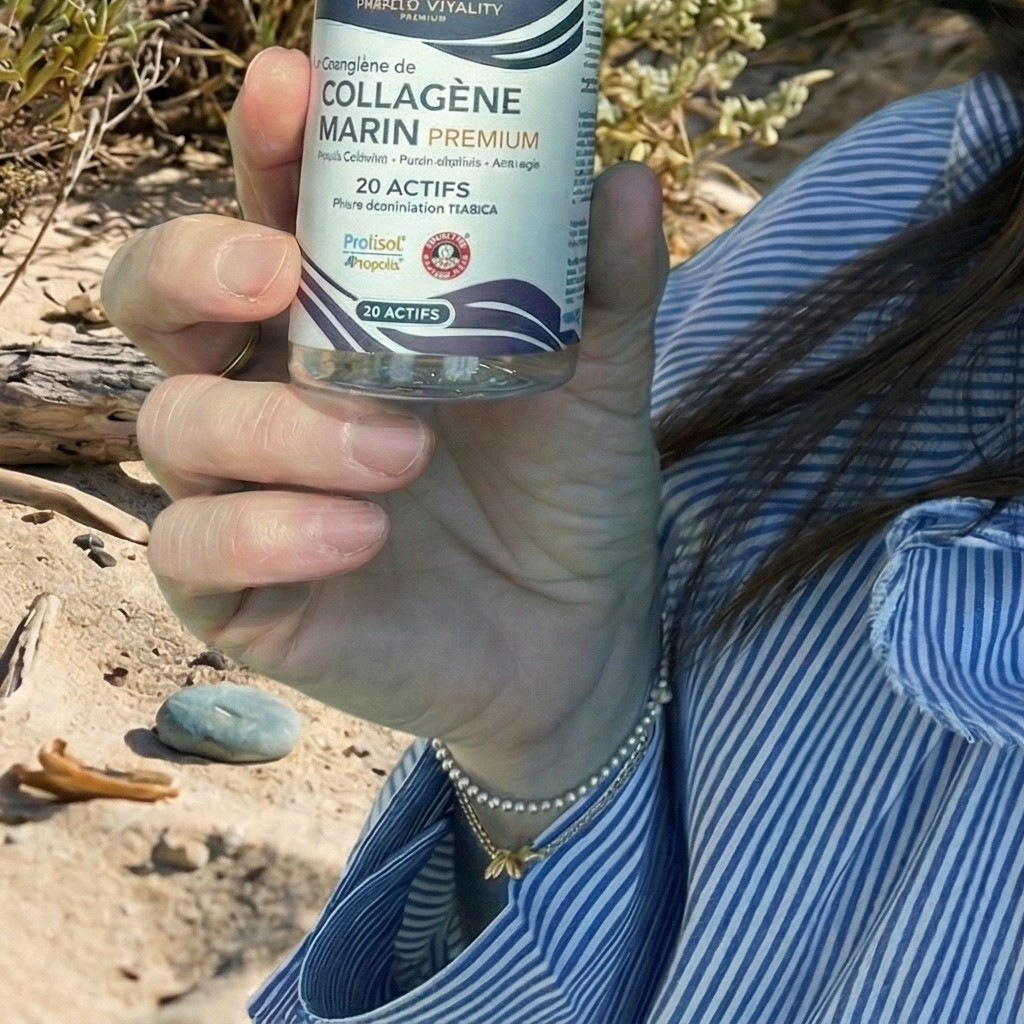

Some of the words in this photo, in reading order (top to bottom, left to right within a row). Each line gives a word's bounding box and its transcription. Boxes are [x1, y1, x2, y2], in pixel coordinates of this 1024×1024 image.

[394, 59, 416, 74] de
[322, 77, 522, 115] COLLAGÈNE
[319, 115, 419, 146] MARIN
[428, 128, 539, 150] PREMIUM
[356, 177, 381, 194] 20
[386, 178, 470, 198] ACTIFS
[363, 305, 381, 318] 20
[386, 306, 441, 321] ACTIFS
